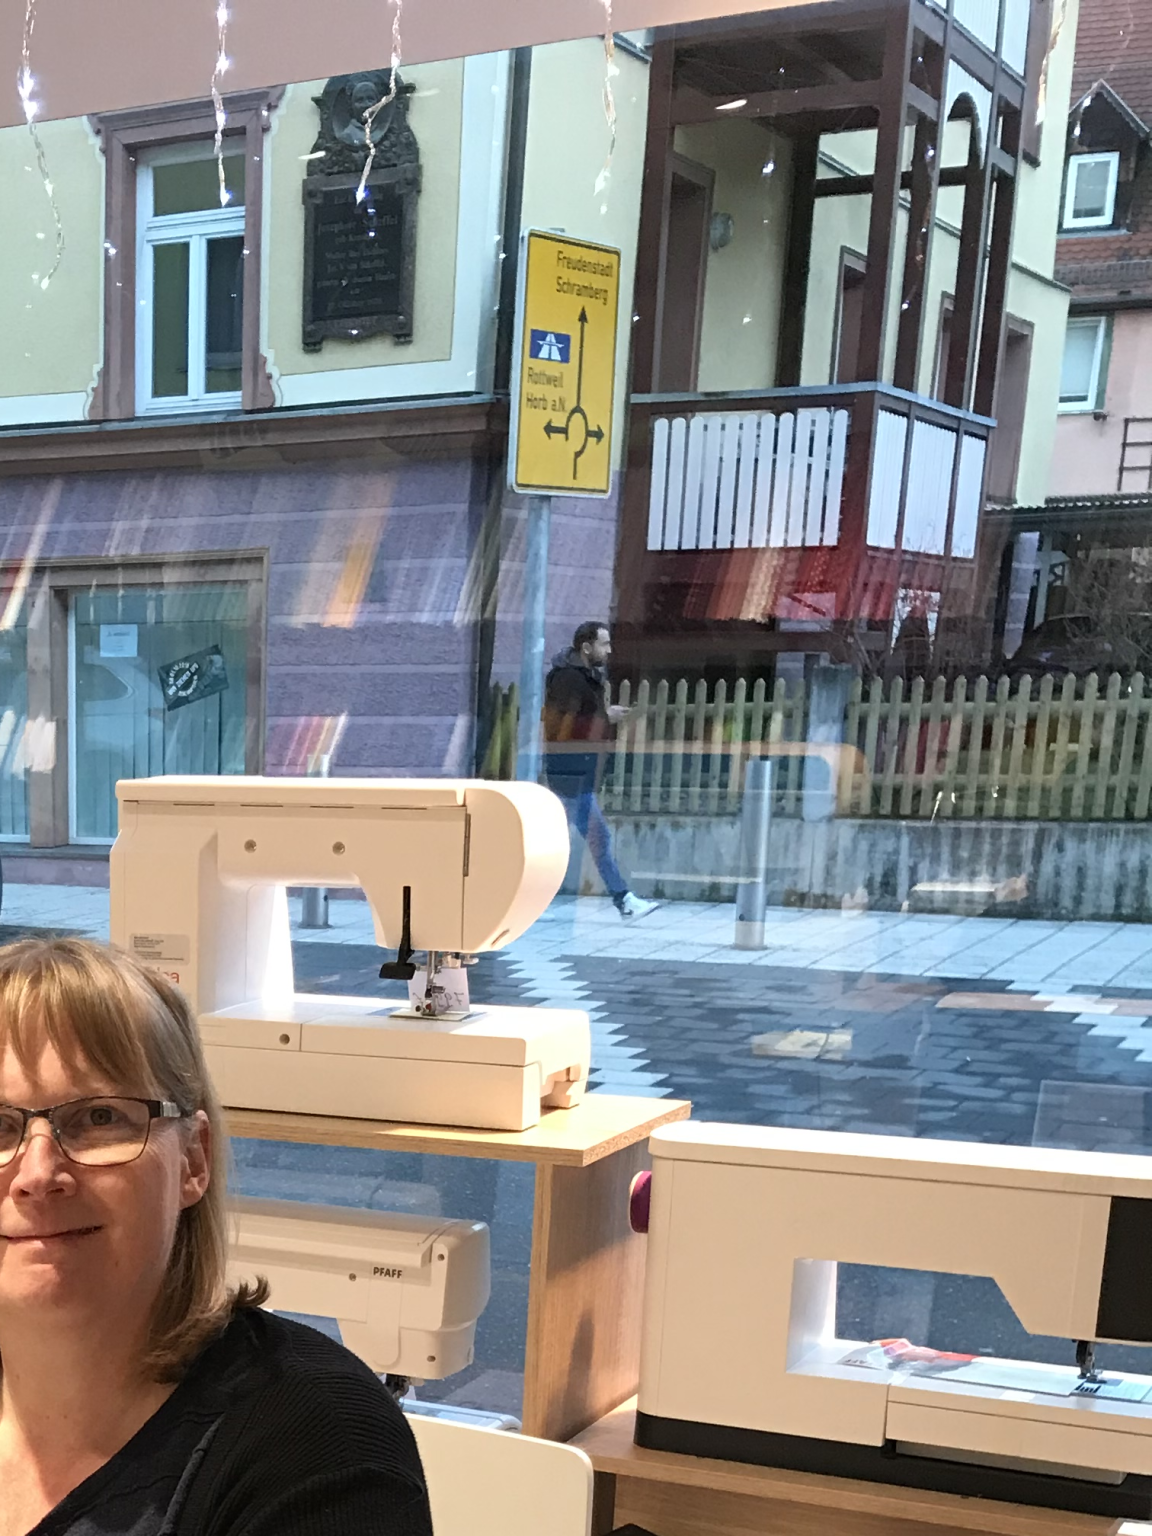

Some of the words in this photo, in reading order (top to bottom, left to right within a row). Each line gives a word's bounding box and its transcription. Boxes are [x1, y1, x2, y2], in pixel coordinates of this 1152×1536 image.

[556, 250, 613, 278] Freudenstadt
[555, 276, 608, 305] Schramberg
[527, 367, 564, 388] Rottweil
[526, 392, 547, 410] Horb
[372, 1266, 403, 1279] PFAFF
